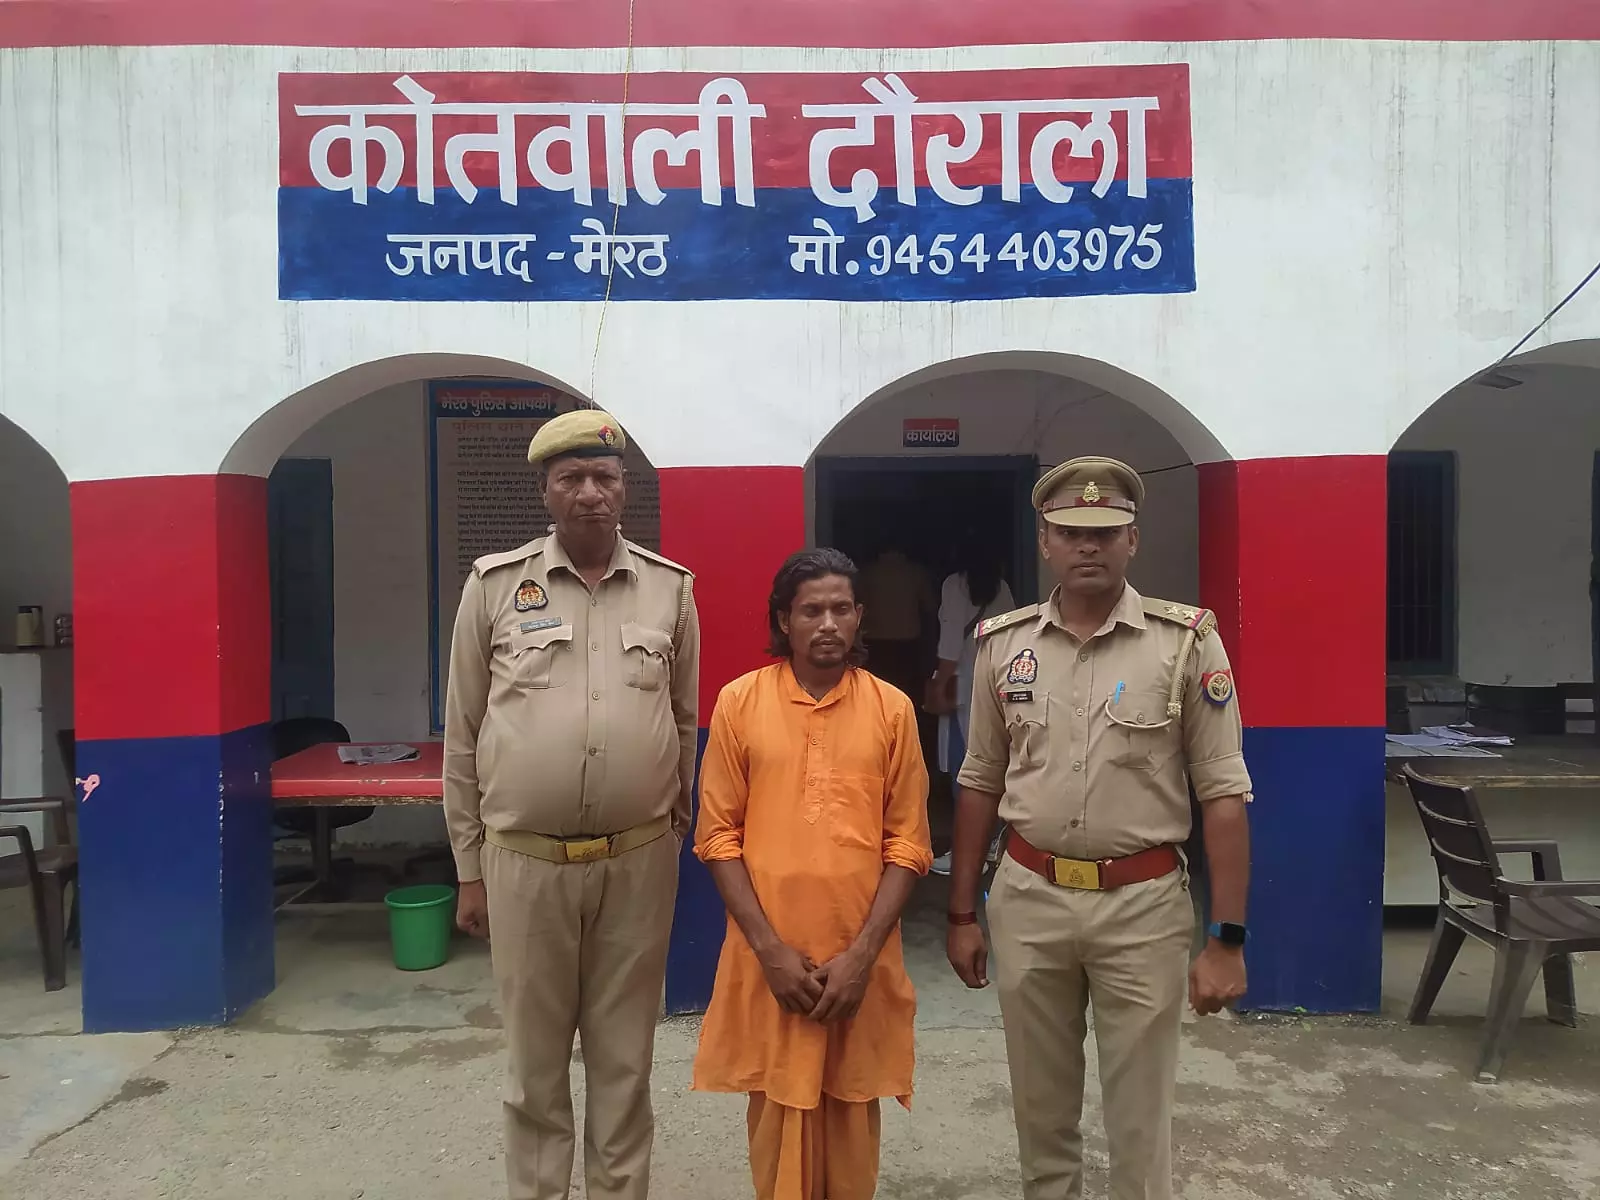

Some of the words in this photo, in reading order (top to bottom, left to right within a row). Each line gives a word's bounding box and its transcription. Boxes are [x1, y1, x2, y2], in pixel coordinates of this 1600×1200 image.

[294, 75, 766, 207] कोतवाली
[801, 73, 1160, 223] दौराला
[386, 233, 537, 283] जनपद
[471, 390, 506, 416] पुलिस
[904, 424, 957, 442] कार्यालय
